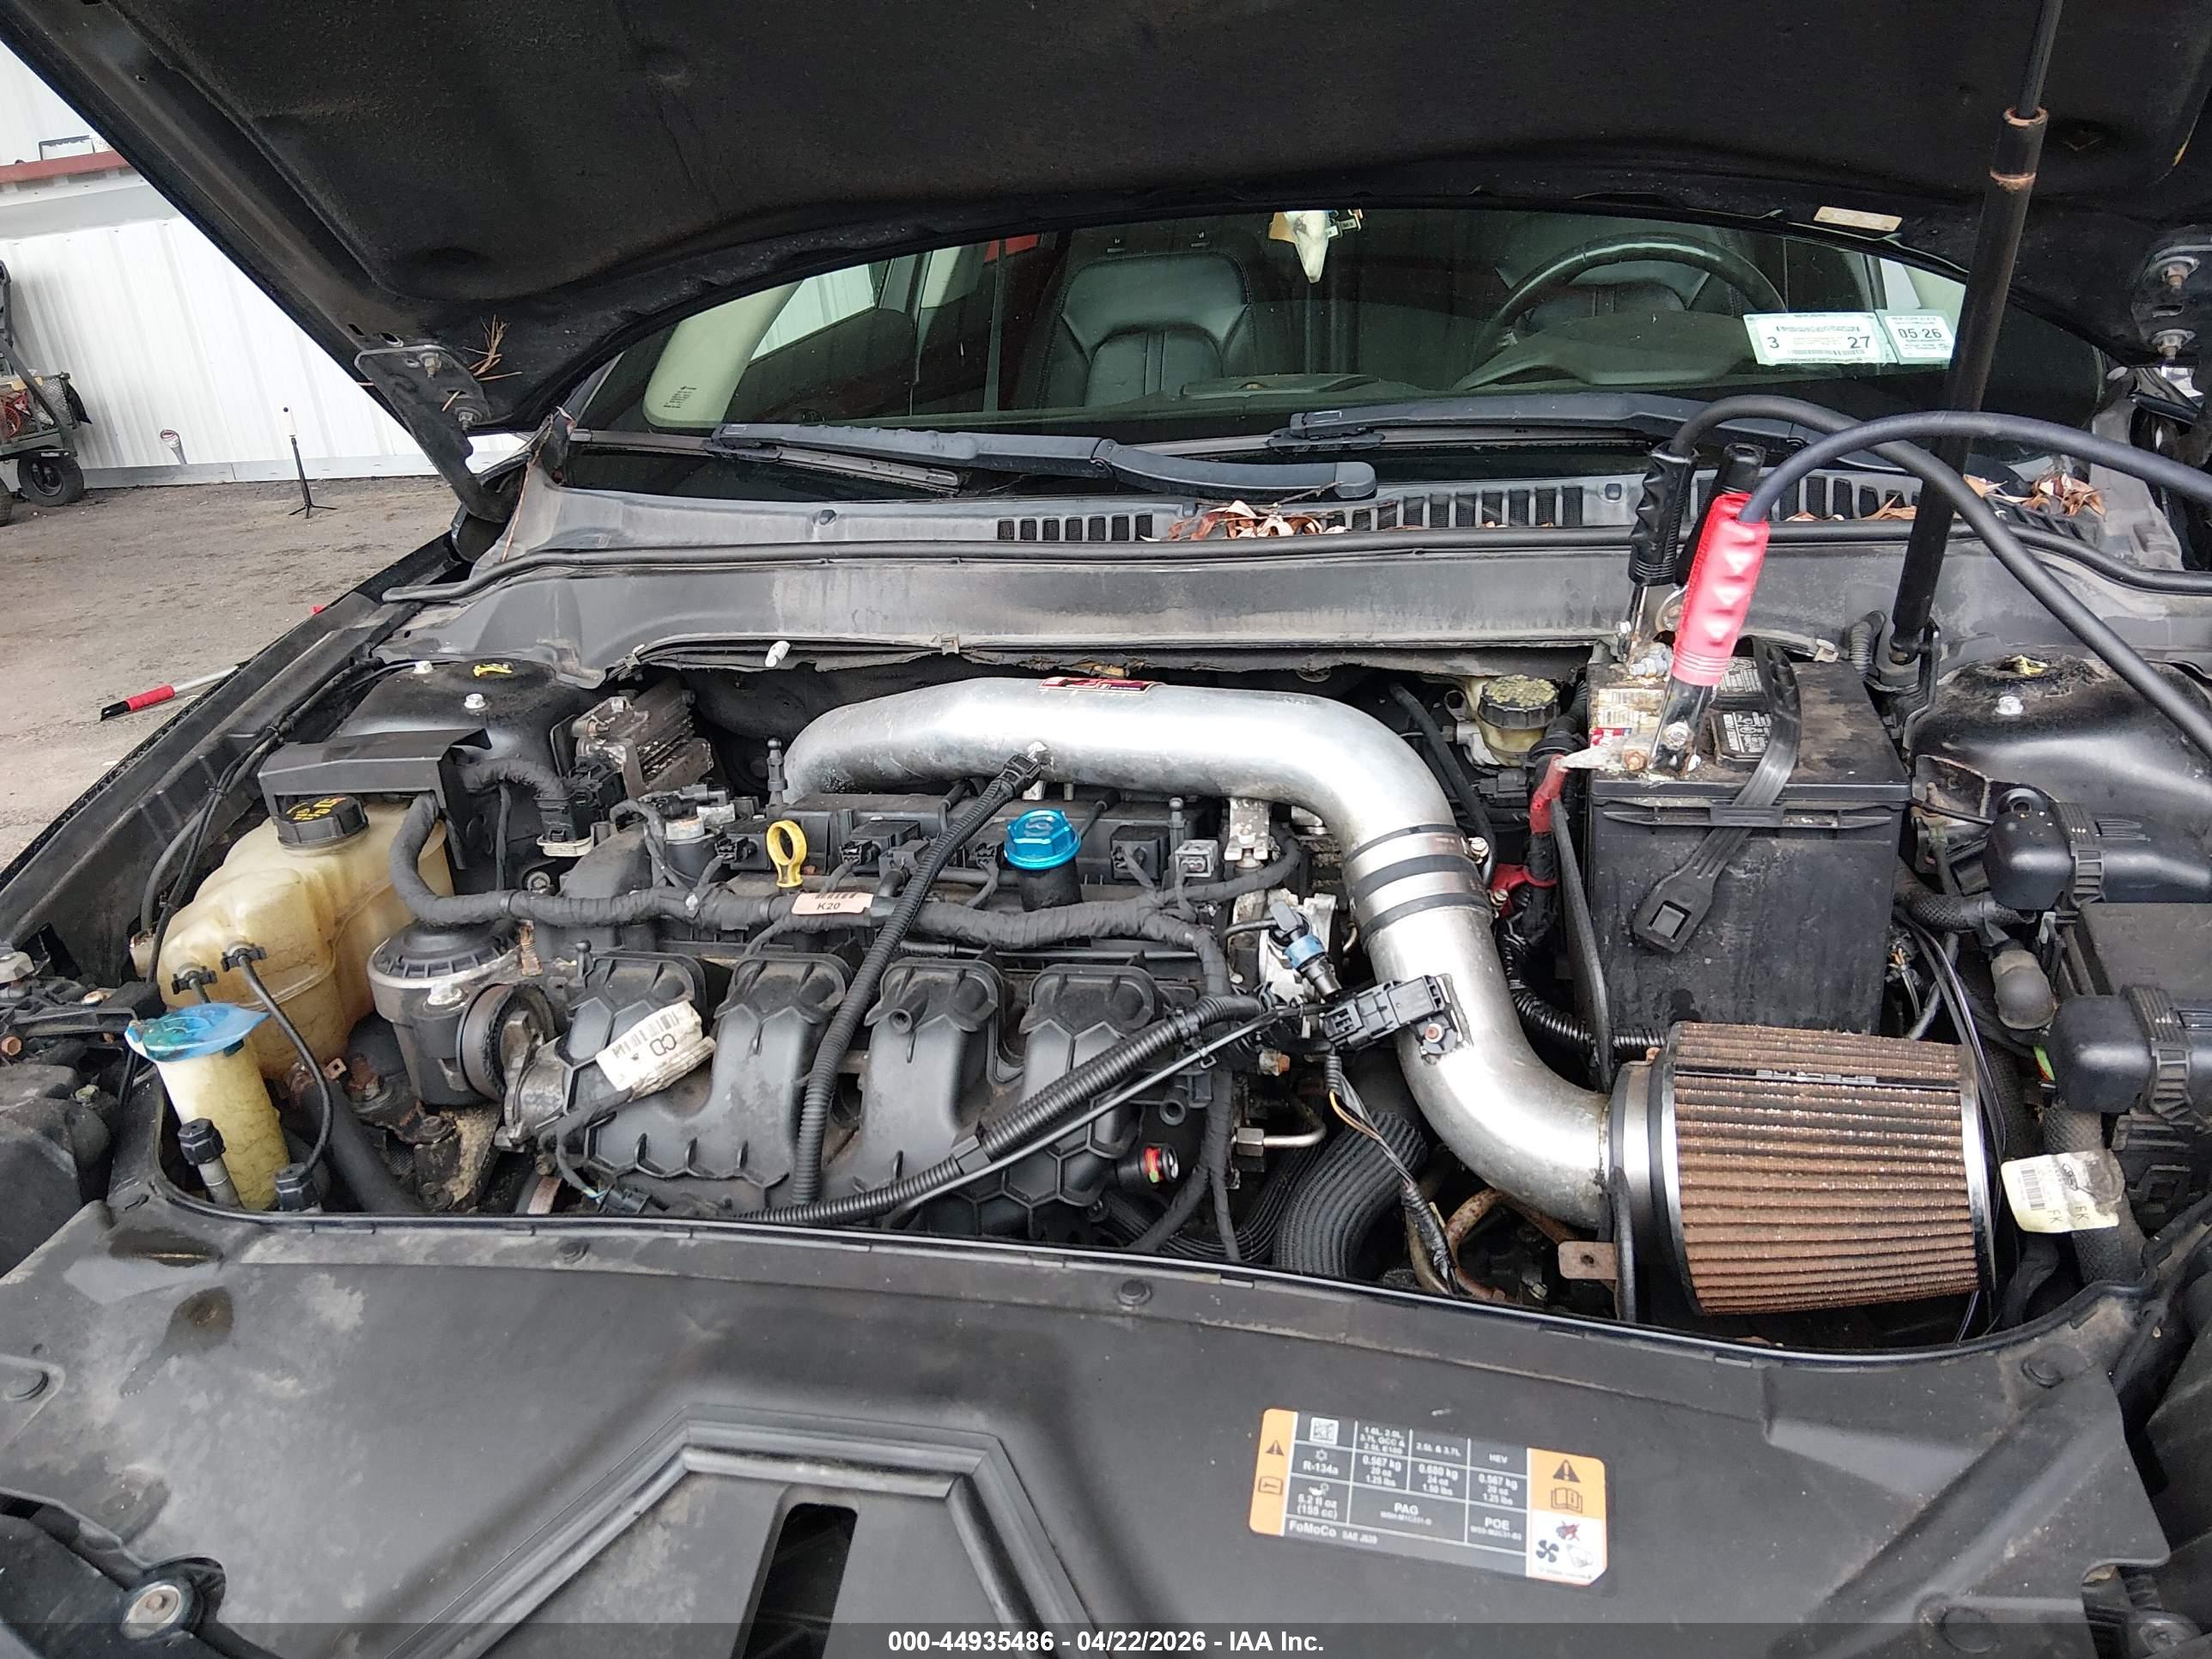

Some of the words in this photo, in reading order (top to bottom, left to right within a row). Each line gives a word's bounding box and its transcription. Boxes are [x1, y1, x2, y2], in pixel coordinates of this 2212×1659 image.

[1766, 336, 1780, 349] 3
[1847, 336, 1870, 349] 27
[817, 902, 842, 910] K20
[2047, 1209, 2063, 1224] FK
[2075, 1206, 2090, 1222] FK
[1489, 1453, 1508, 1464] HEV
[1303, 1460, 1340, 1475] R-134a
[1389, 1459, 1402, 1473] kg
[1445, 1468, 1459, 1481] kg
[1505, 1478, 1518, 1492] kg
[1324, 1499, 1338, 1509] oz
[1394, 1502, 1419, 1516] PAG
[1289, 1519, 1337, 1538] FoMoCo
[1484, 1516, 1510, 1531] POE
